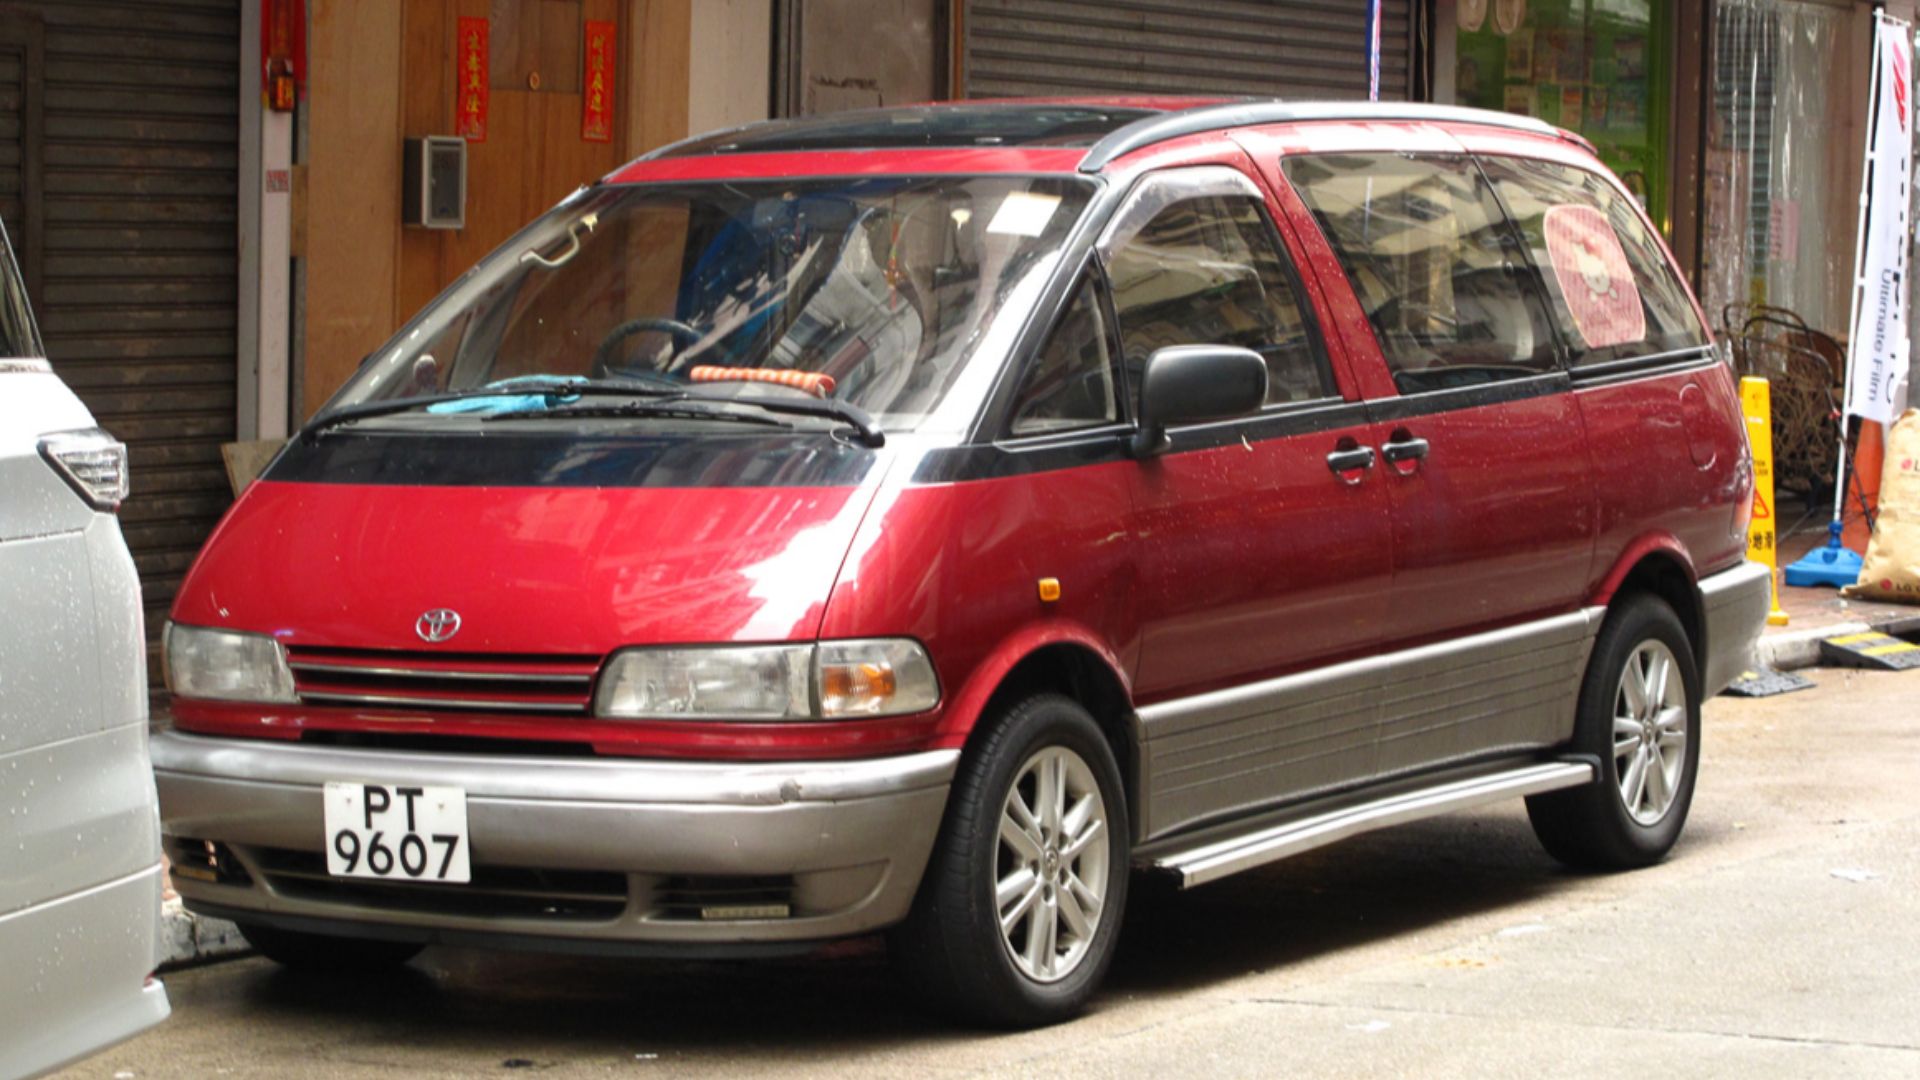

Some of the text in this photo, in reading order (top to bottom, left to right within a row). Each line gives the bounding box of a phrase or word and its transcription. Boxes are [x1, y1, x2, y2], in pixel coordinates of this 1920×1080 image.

[1867, 268, 1892, 402] Ultimate Film
[1749, 530, 1774, 551] 地滑
[363, 785, 424, 832] PT
[334, 829, 459, 879] 9607
